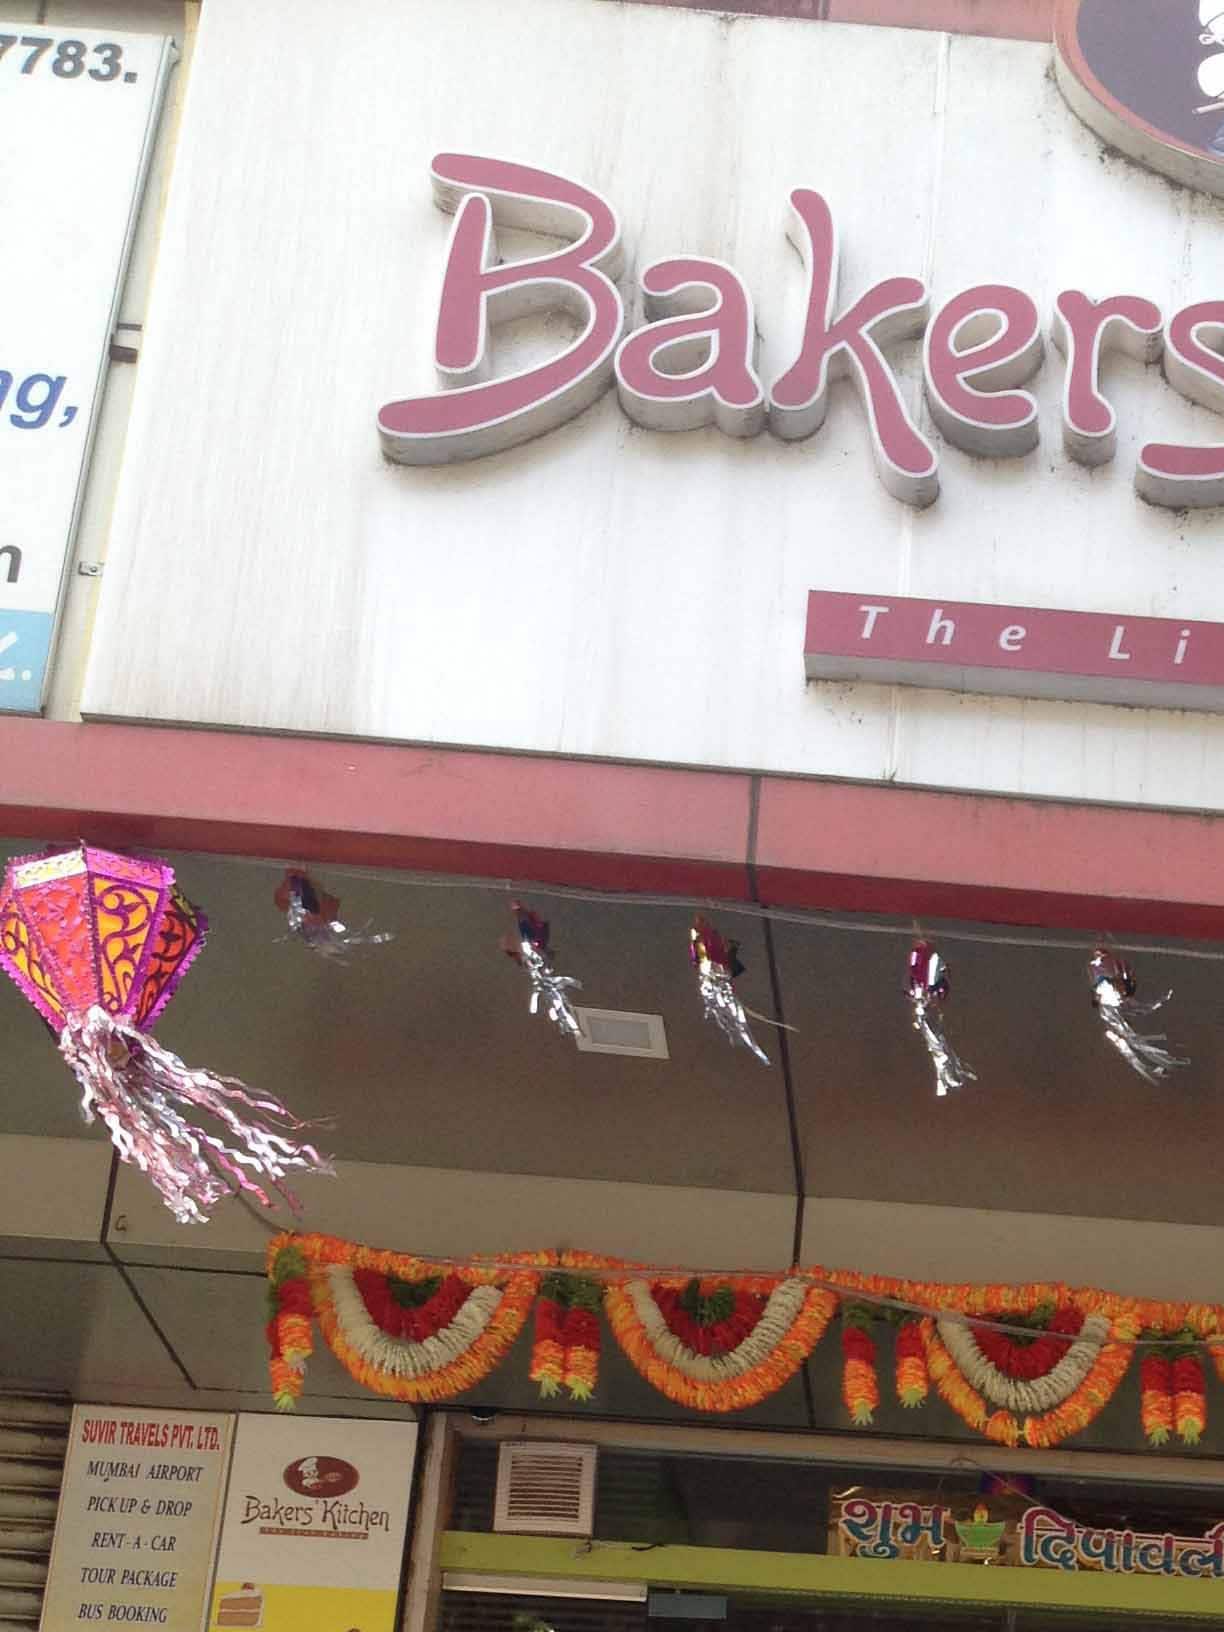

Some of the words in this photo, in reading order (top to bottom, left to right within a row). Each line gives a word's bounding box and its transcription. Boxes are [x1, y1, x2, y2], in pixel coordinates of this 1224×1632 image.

[857, 604, 1027, 653] The
[82, 1419, 117, 1444] SUVIR
[120, 1421, 169, 1447] TRAVELS
[170, 1424, 194, 1449] PVT.
[197, 1426, 220, 1450] LTD.
[86, 1460, 141, 1480] MUMBAI
[145, 1463, 204, 1483] AIRPORT
[140, 1499, 152, 1515] &
[155, 1500, 193, 1517] DROP
[321, 1499, 390, 1532] Kitchen
[80, 1566, 117, 1585] TOUR
[121, 1568, 178, 1588] PACKAGE
[78, 1602, 103, 1620] BUS
[107, 1604, 168, 1624] BOOKING
